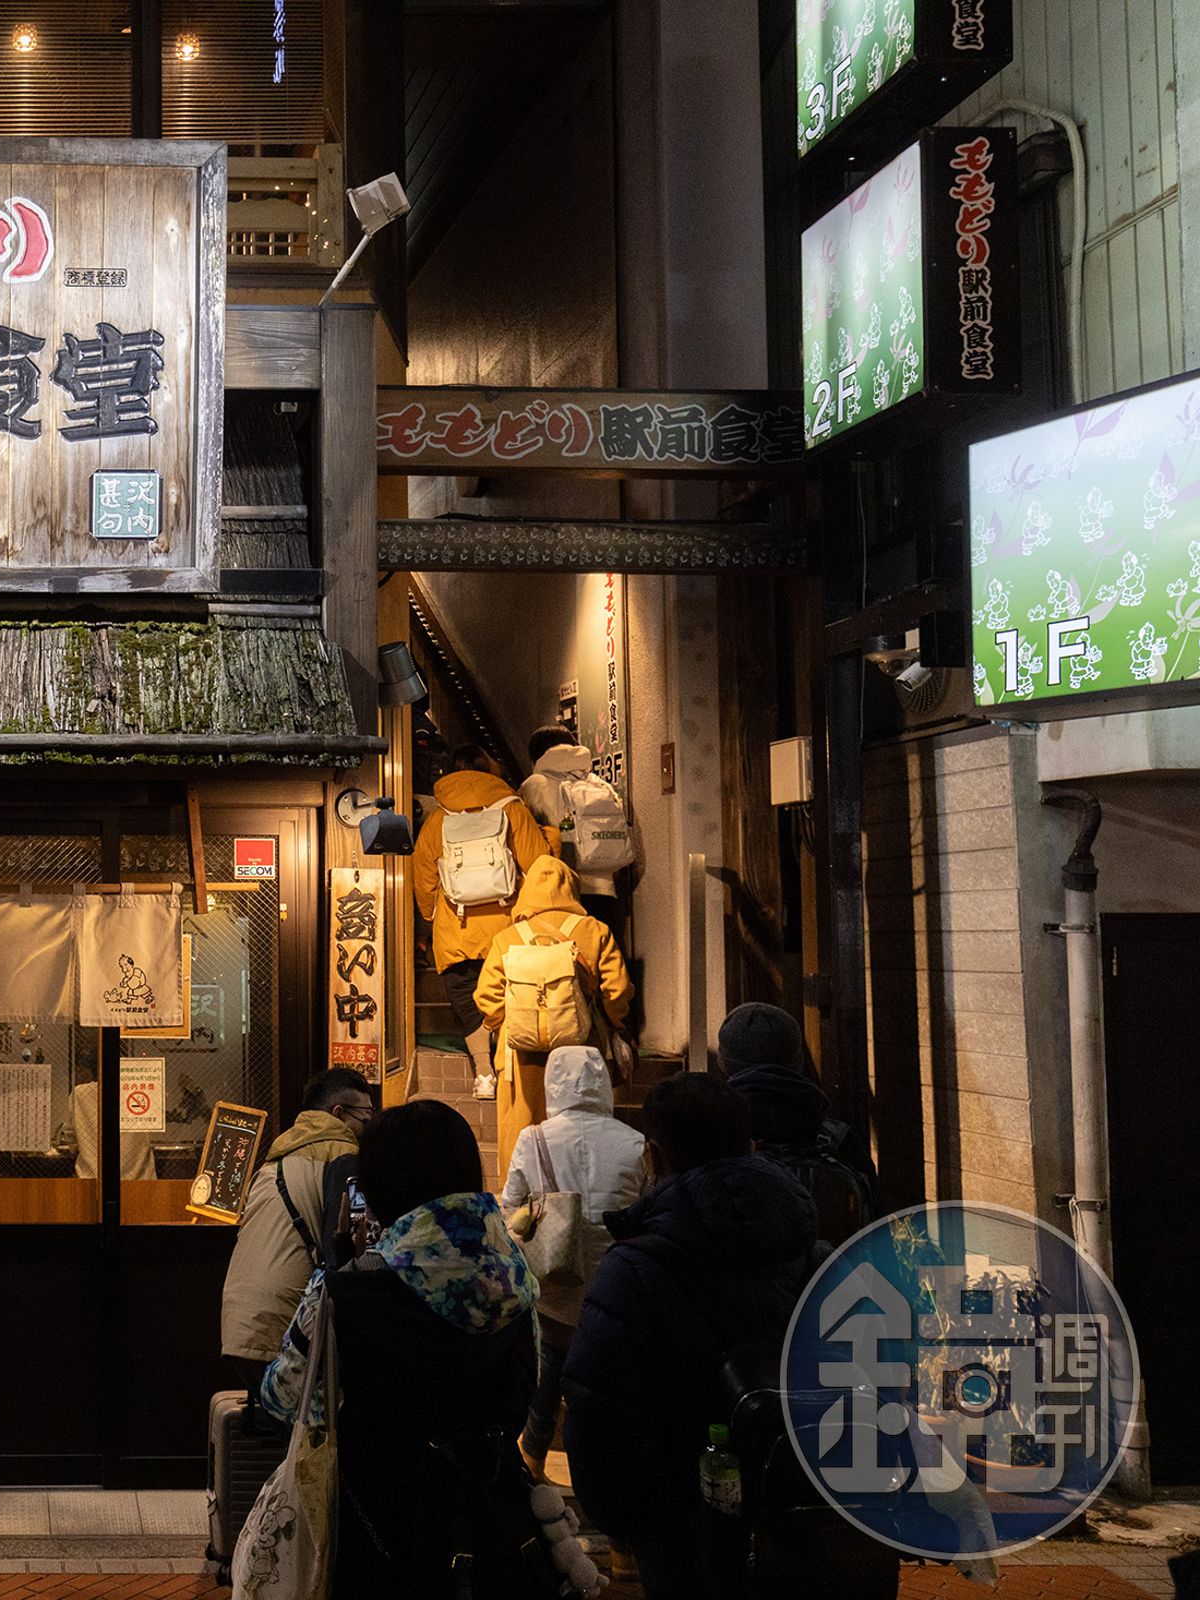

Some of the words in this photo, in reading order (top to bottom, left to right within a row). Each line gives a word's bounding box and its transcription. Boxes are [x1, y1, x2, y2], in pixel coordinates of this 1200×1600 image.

[805, 53, 853, 142] 3F
[65, 269, 127, 287] 商標登録
[949, 136, 995, 380] ももどり駅前食堂
[811, 361, 858, 438] 2F
[994, 615, 1091, 693] 1F
[237, 866, 273, 876] SECOM
[591, 830, 626, 840] SKECHERS
